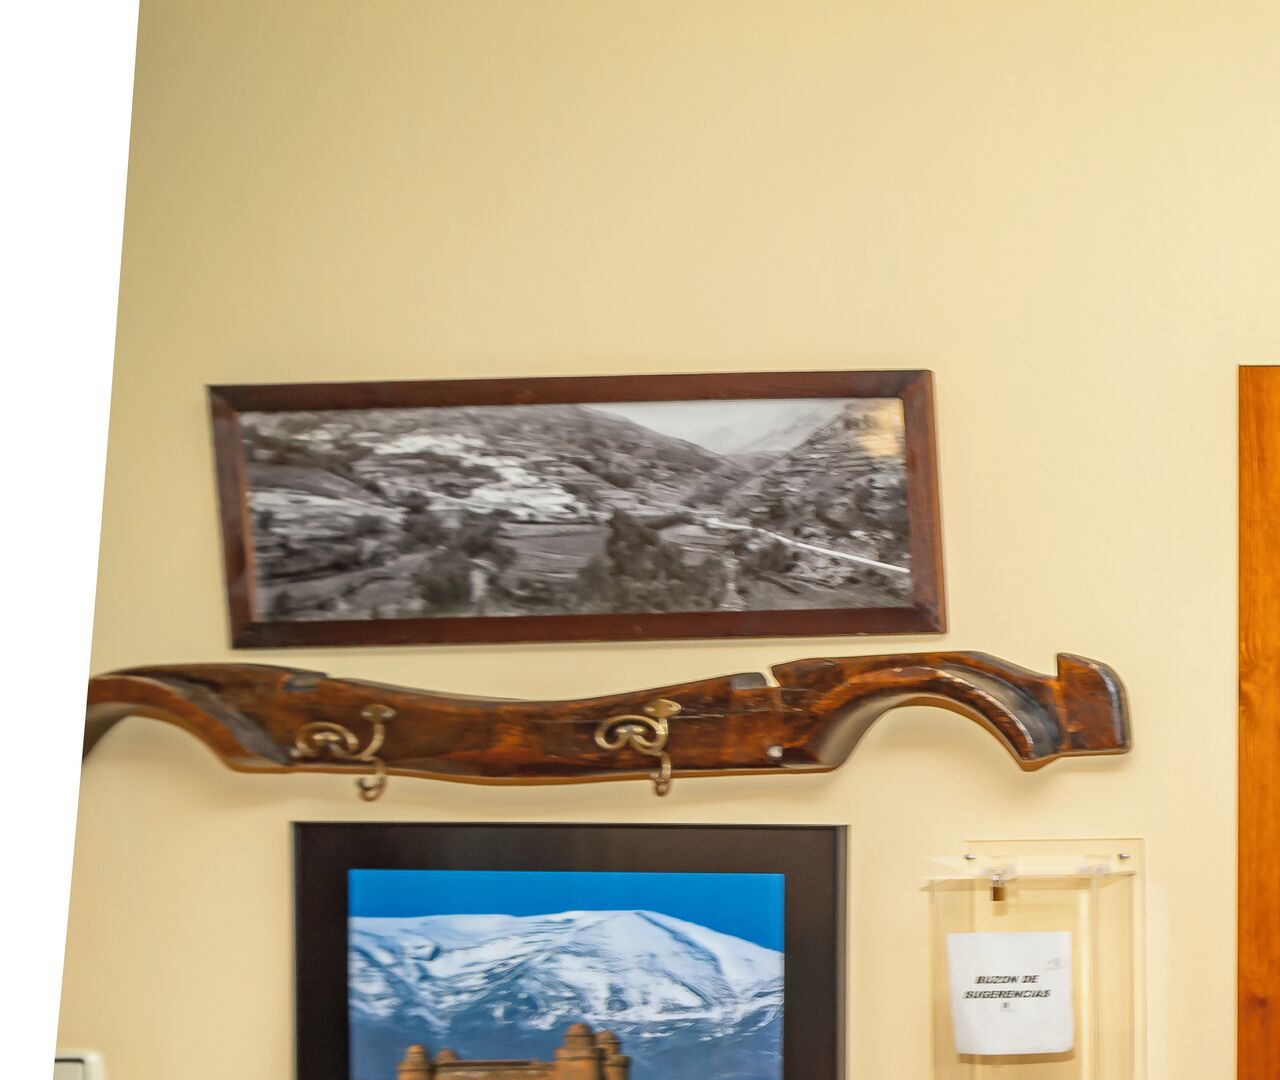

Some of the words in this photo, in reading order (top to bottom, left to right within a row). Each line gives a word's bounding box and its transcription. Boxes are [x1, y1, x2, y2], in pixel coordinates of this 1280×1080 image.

[975, 975, 1019, 984] BUZON
[1021, 975, 1040, 984] DE
[964, 989, 1052, 999] SUGERENCIAS
